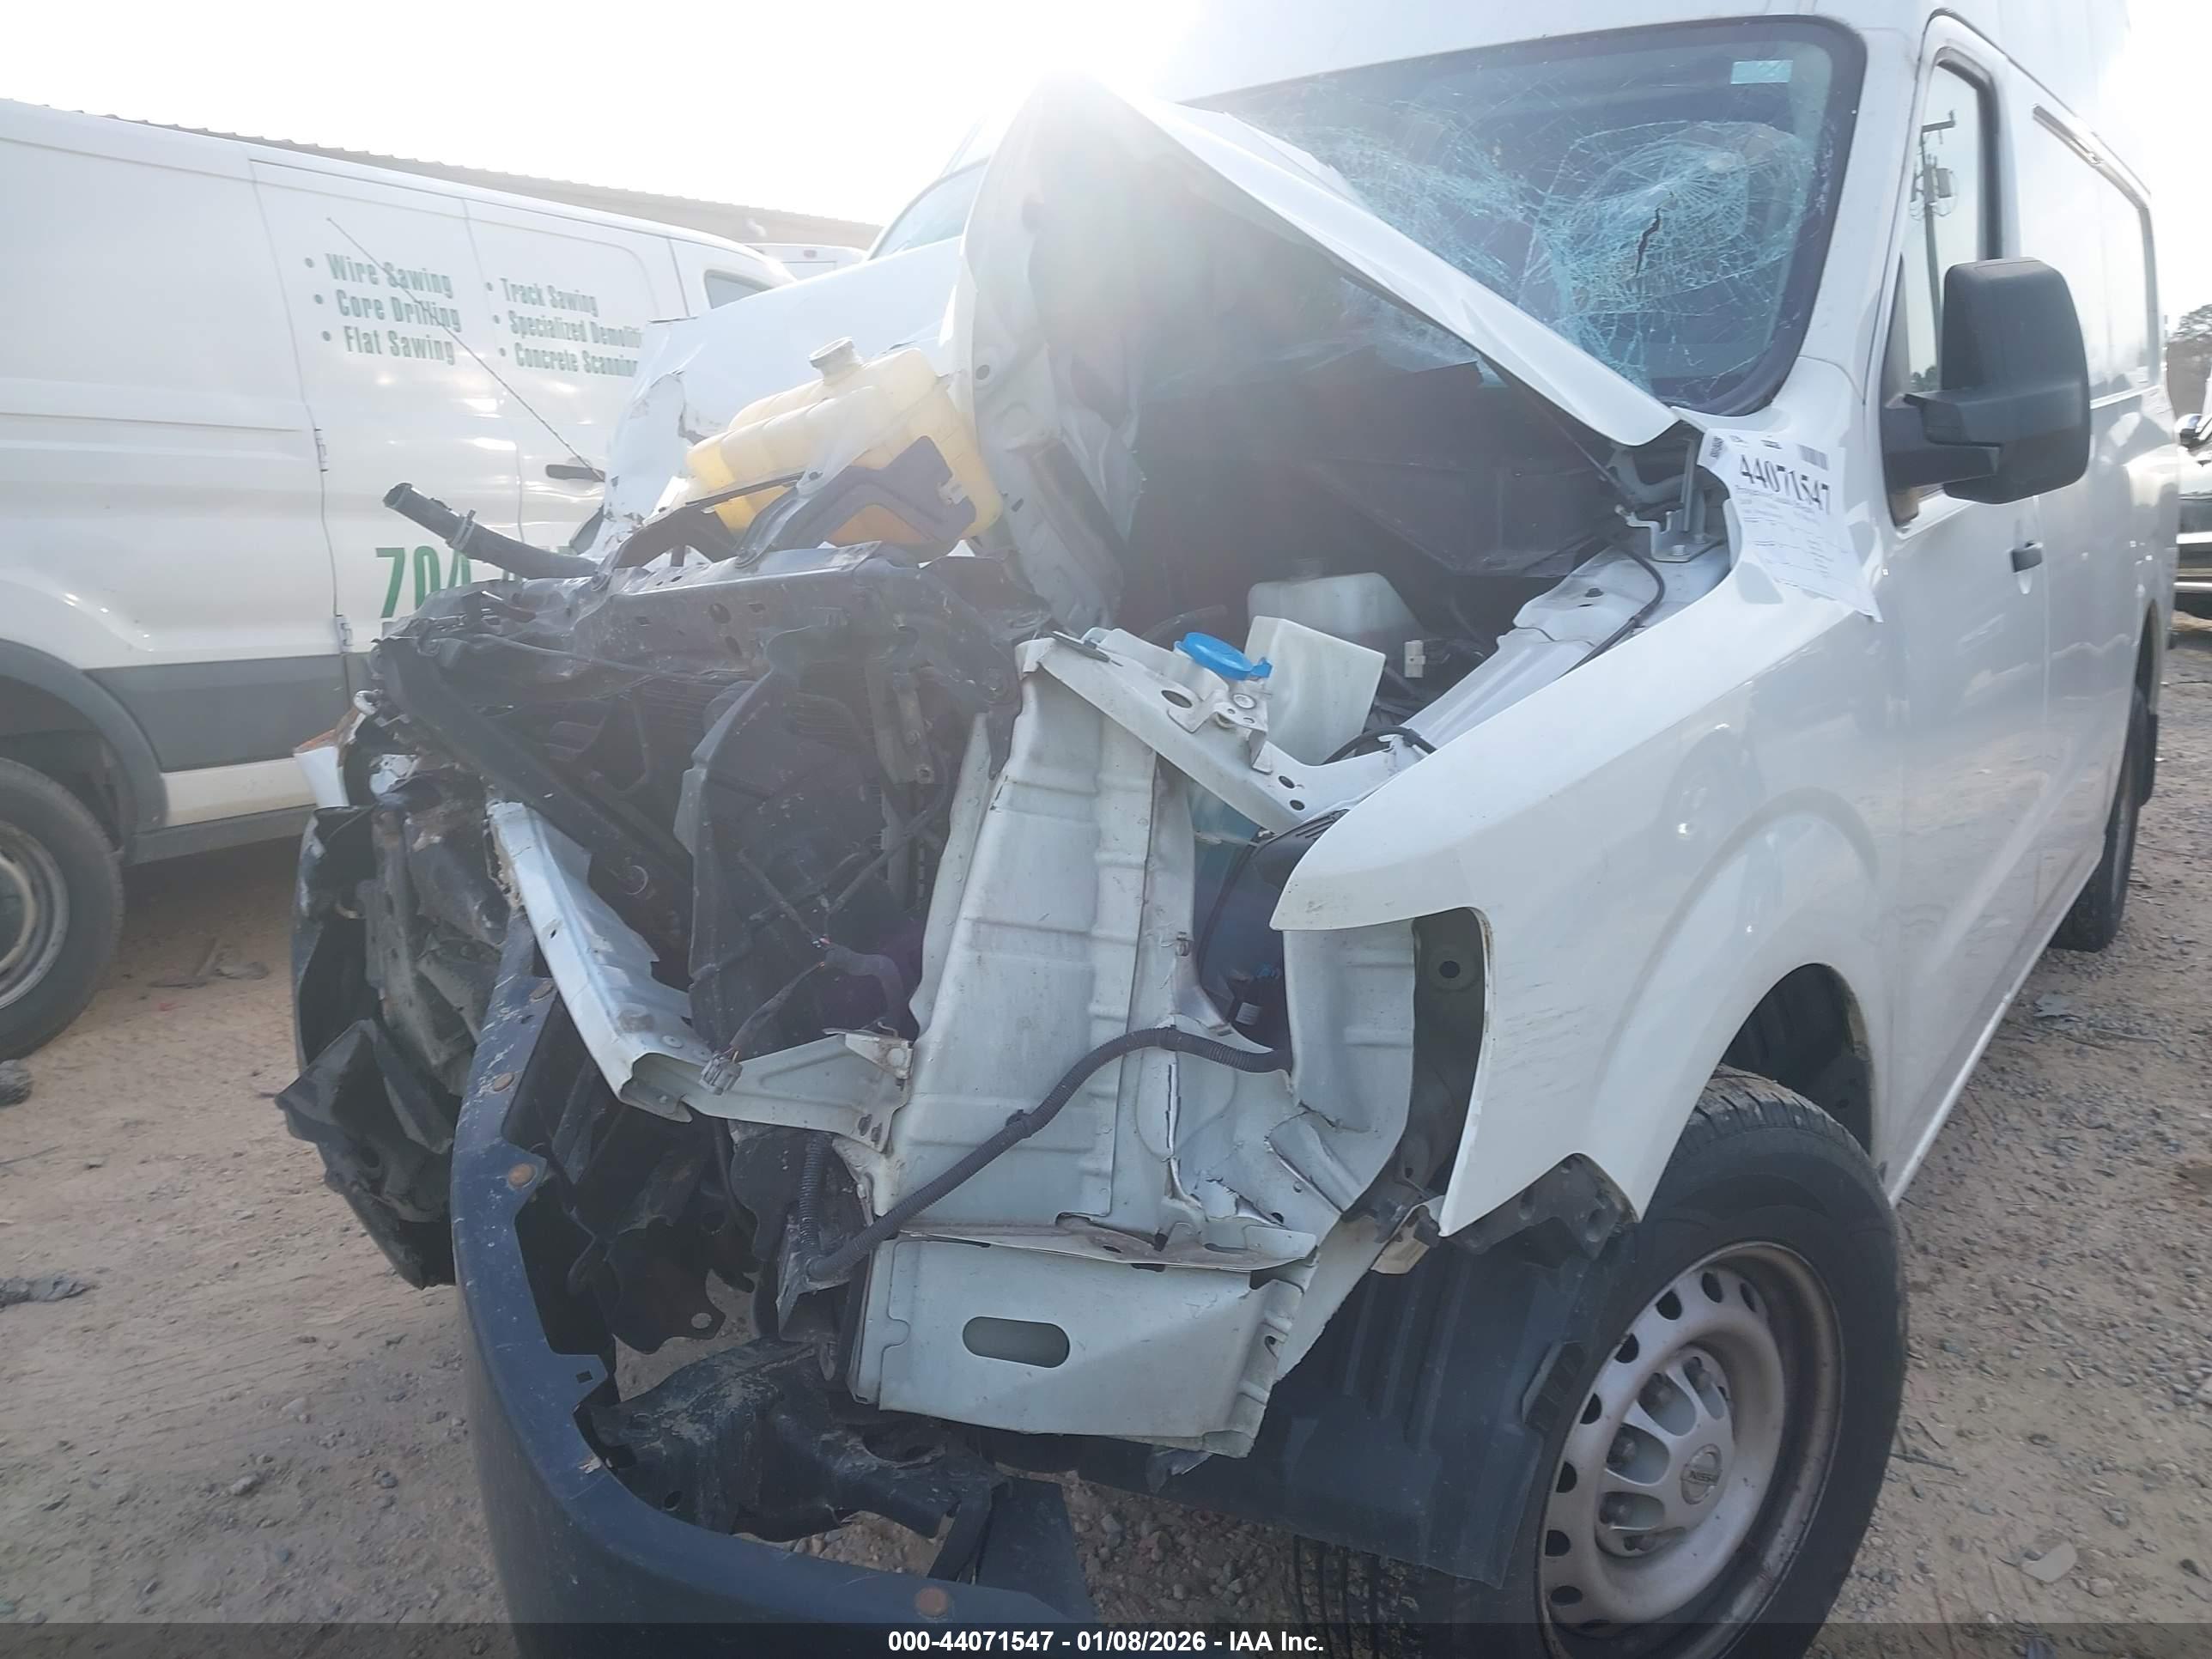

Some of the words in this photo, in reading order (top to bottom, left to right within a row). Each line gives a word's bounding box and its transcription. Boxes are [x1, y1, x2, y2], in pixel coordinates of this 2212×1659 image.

[325, 252, 379, 285] Wire
[383, 261, 454, 300] Sawing
[499, 276, 547, 307] Track
[547, 284, 599, 318] Sawing
[336, 289, 386, 320] Core
[390, 296, 463, 333] Drilling
[508, 309, 587, 343] Specialized
[343, 325, 383, 355] Flat
[386, 329, 456, 367] Sawing
[514, 341, 579, 373] Concrete
